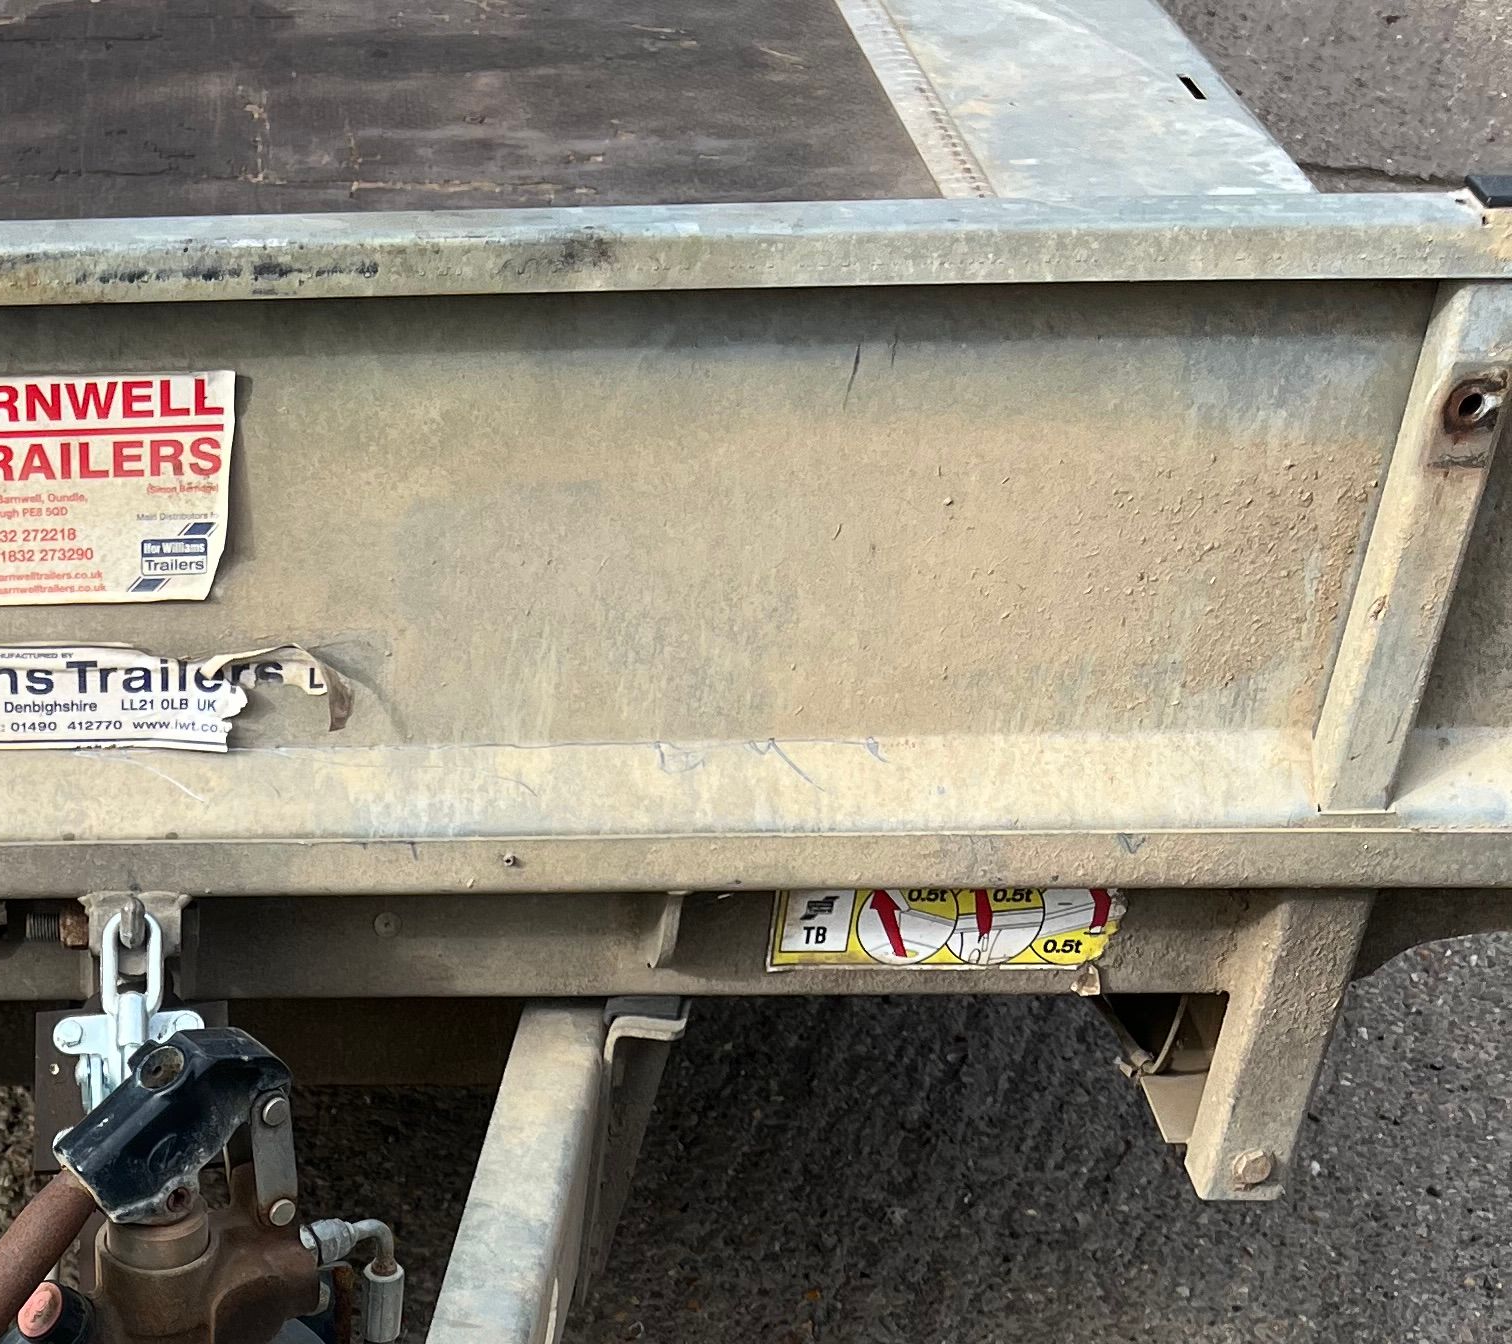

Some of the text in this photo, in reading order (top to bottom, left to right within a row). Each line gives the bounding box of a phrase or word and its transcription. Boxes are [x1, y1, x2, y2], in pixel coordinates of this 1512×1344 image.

[22, 507, 43, 518] PE8
[45, 506, 68, 517] 5QD
[22, 528, 77, 542] 272218
[162, 541, 205, 554] Williams
[39, 548, 94, 562] 273290
[144, 558, 205, 571] Trailers
[4, 700, 98, 715] Denbighshire
[121, 698, 155, 712] LL21
[160, 698, 189, 711] 0LB
[197, 699, 217, 713] UK
[10, 721, 58, 732] 01490
[67, 720, 123, 731] 412770
[908, 889, 948, 903] 0.5t
[992, 889, 1033, 903] 0.5t
[803, 926, 827, 945] TB
[1043, 939, 1083, 954] 0.5t
